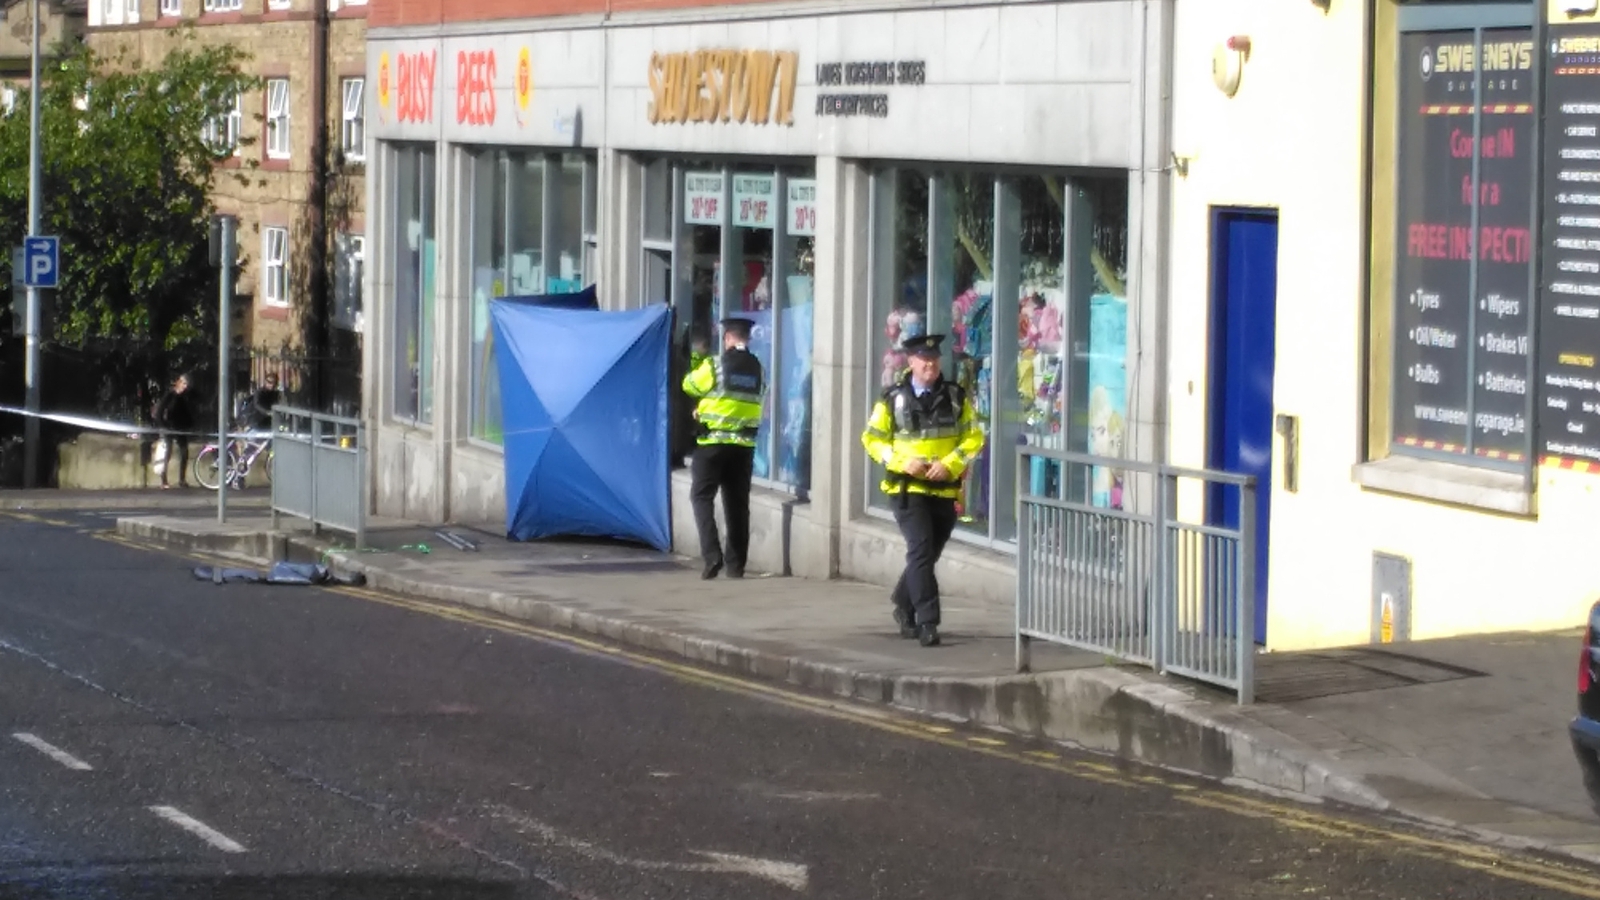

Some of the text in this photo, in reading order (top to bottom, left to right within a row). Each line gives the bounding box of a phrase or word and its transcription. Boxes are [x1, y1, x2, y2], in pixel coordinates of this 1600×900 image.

[1434, 42, 1533, 73] SWEENEYS
[396, 48, 496, 126] BUSY BEES
[1451, 128, 1515, 158] Come IN
[1490, 182, 1500, 205] a
[1408, 223, 1447, 258] FREE
[31, 254, 52, 283] P
[1416, 288, 1440, 313] Tyres
[1487, 294, 1519, 319] Wipers
[1486, 332, 1517, 354] Brakes
[1415, 363, 1440, 385] Bulbs
[1484, 371, 1526, 394] Batteries
[1414, 404, 1525, 436] www.sweenysgarage.ie
